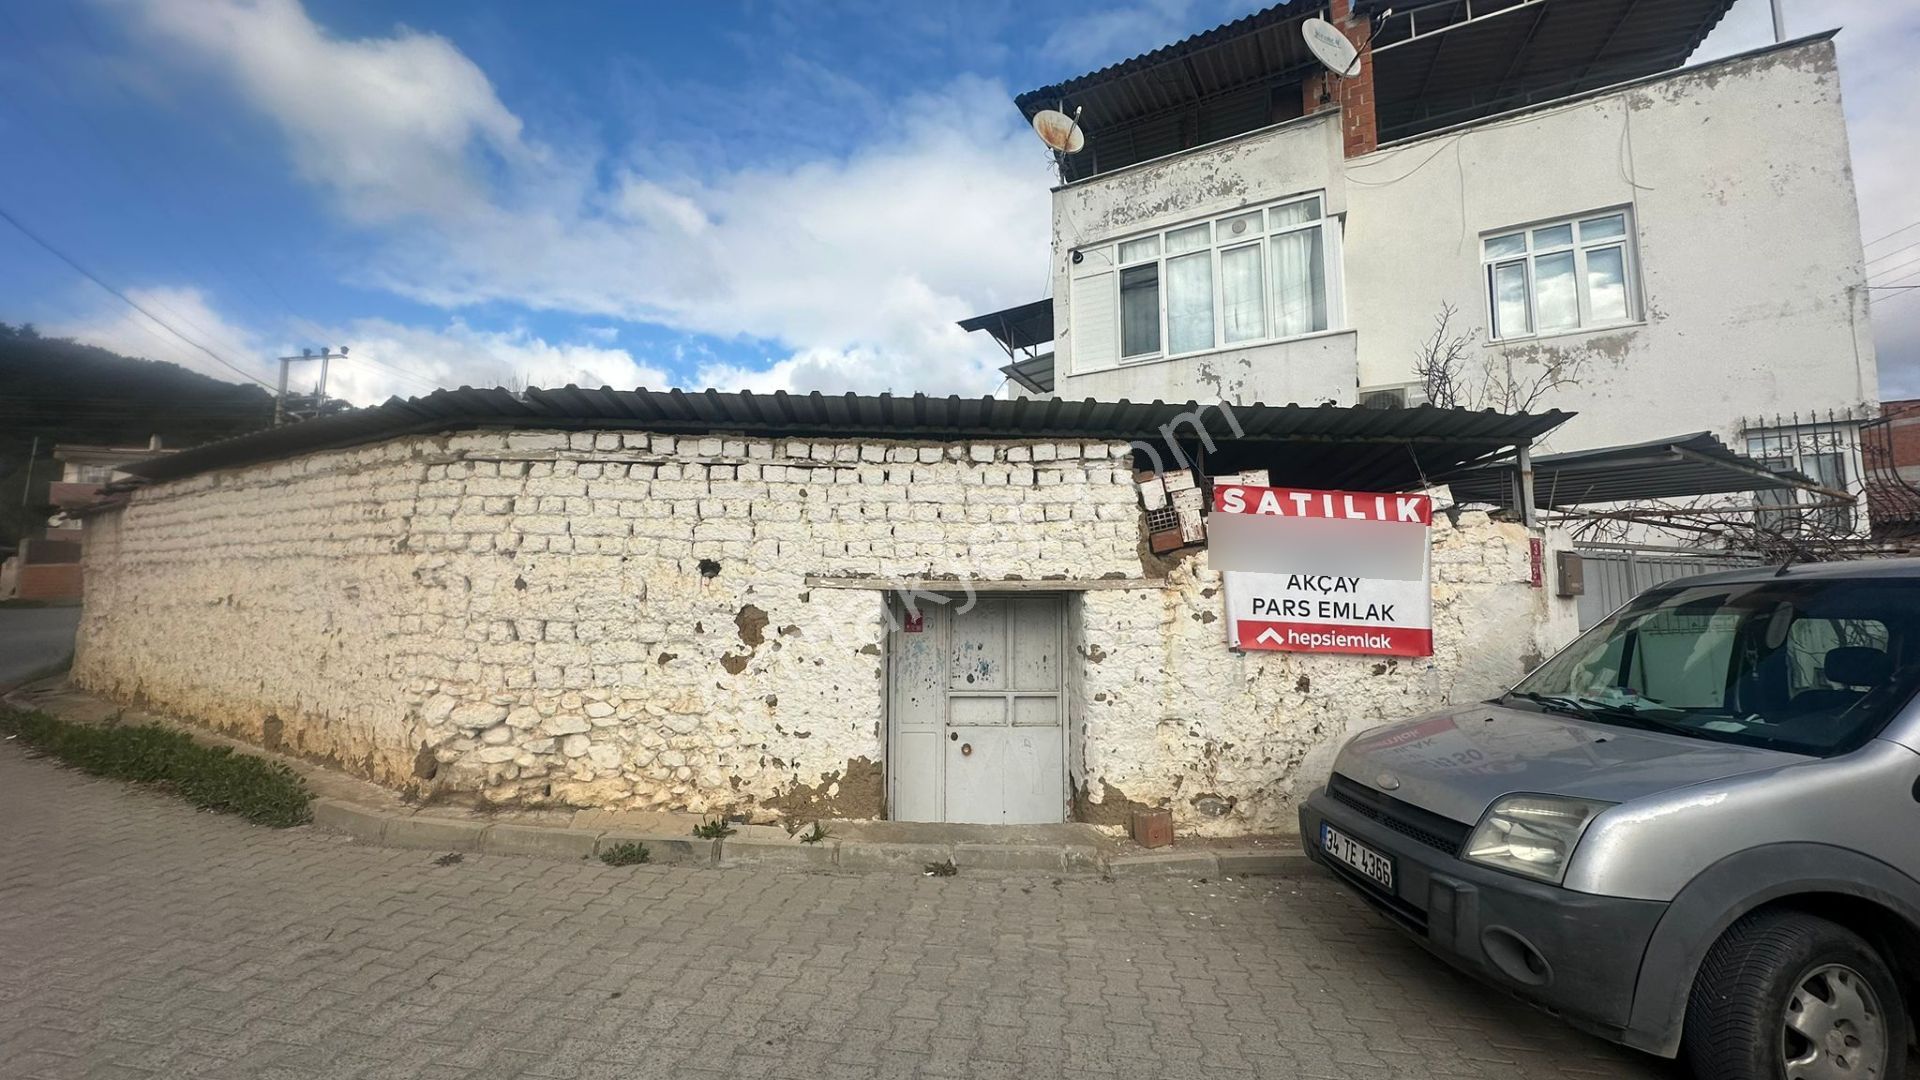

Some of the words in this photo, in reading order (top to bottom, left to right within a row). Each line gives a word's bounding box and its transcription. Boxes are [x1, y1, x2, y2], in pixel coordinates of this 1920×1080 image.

[1222, 488, 1421, 523] SATILIK
[1286, 574, 1360, 595] AKÇAY
[1252, 598, 1310, 617] PARS
[1318, 601, 1394, 622] EMLAK
[1288, 629, 1392, 649] hepsiemlak
[1326, 830, 1340, 855] 34
[1344, 838, 1357, 866] TE
[1361, 849, 1390, 886] 4366
